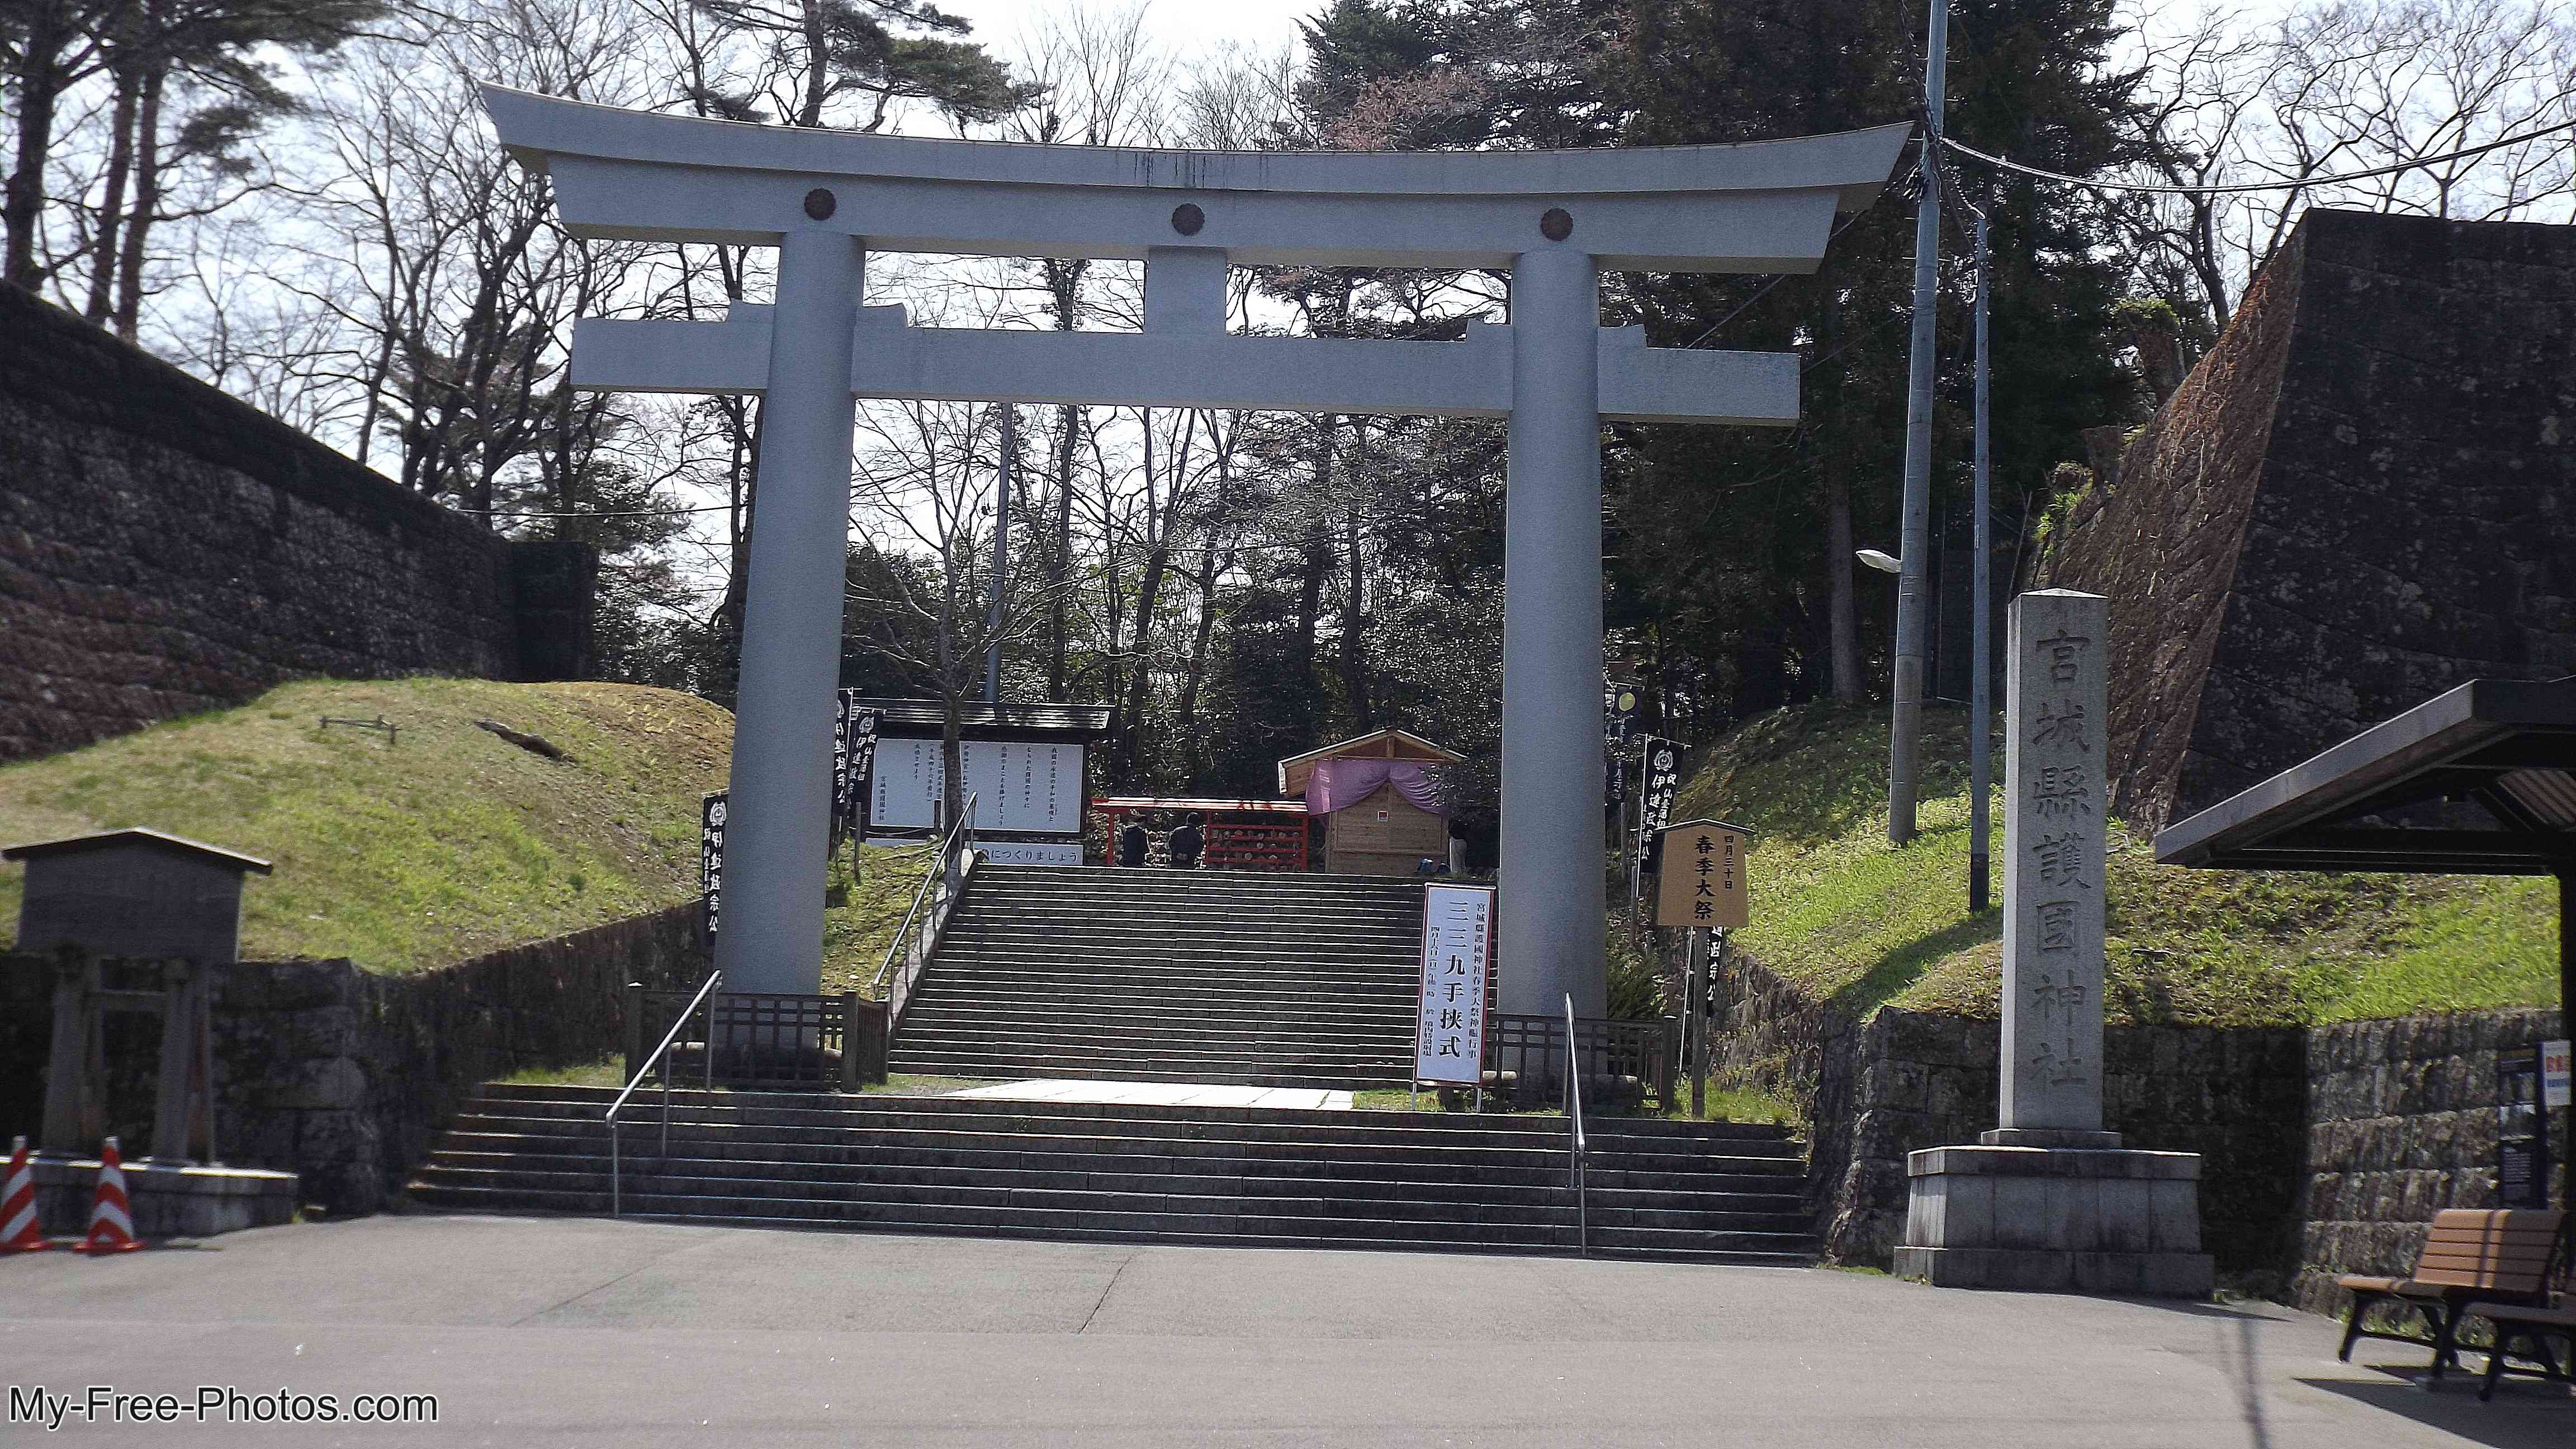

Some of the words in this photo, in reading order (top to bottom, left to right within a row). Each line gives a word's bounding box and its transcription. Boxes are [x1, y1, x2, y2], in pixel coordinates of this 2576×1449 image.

[1694, 835, 1716, 921] 春季大祭
[1723, 836, 1735, 890] 四月三十日
[2032, 628, 2091, 1087] 宮城縣護國神社
